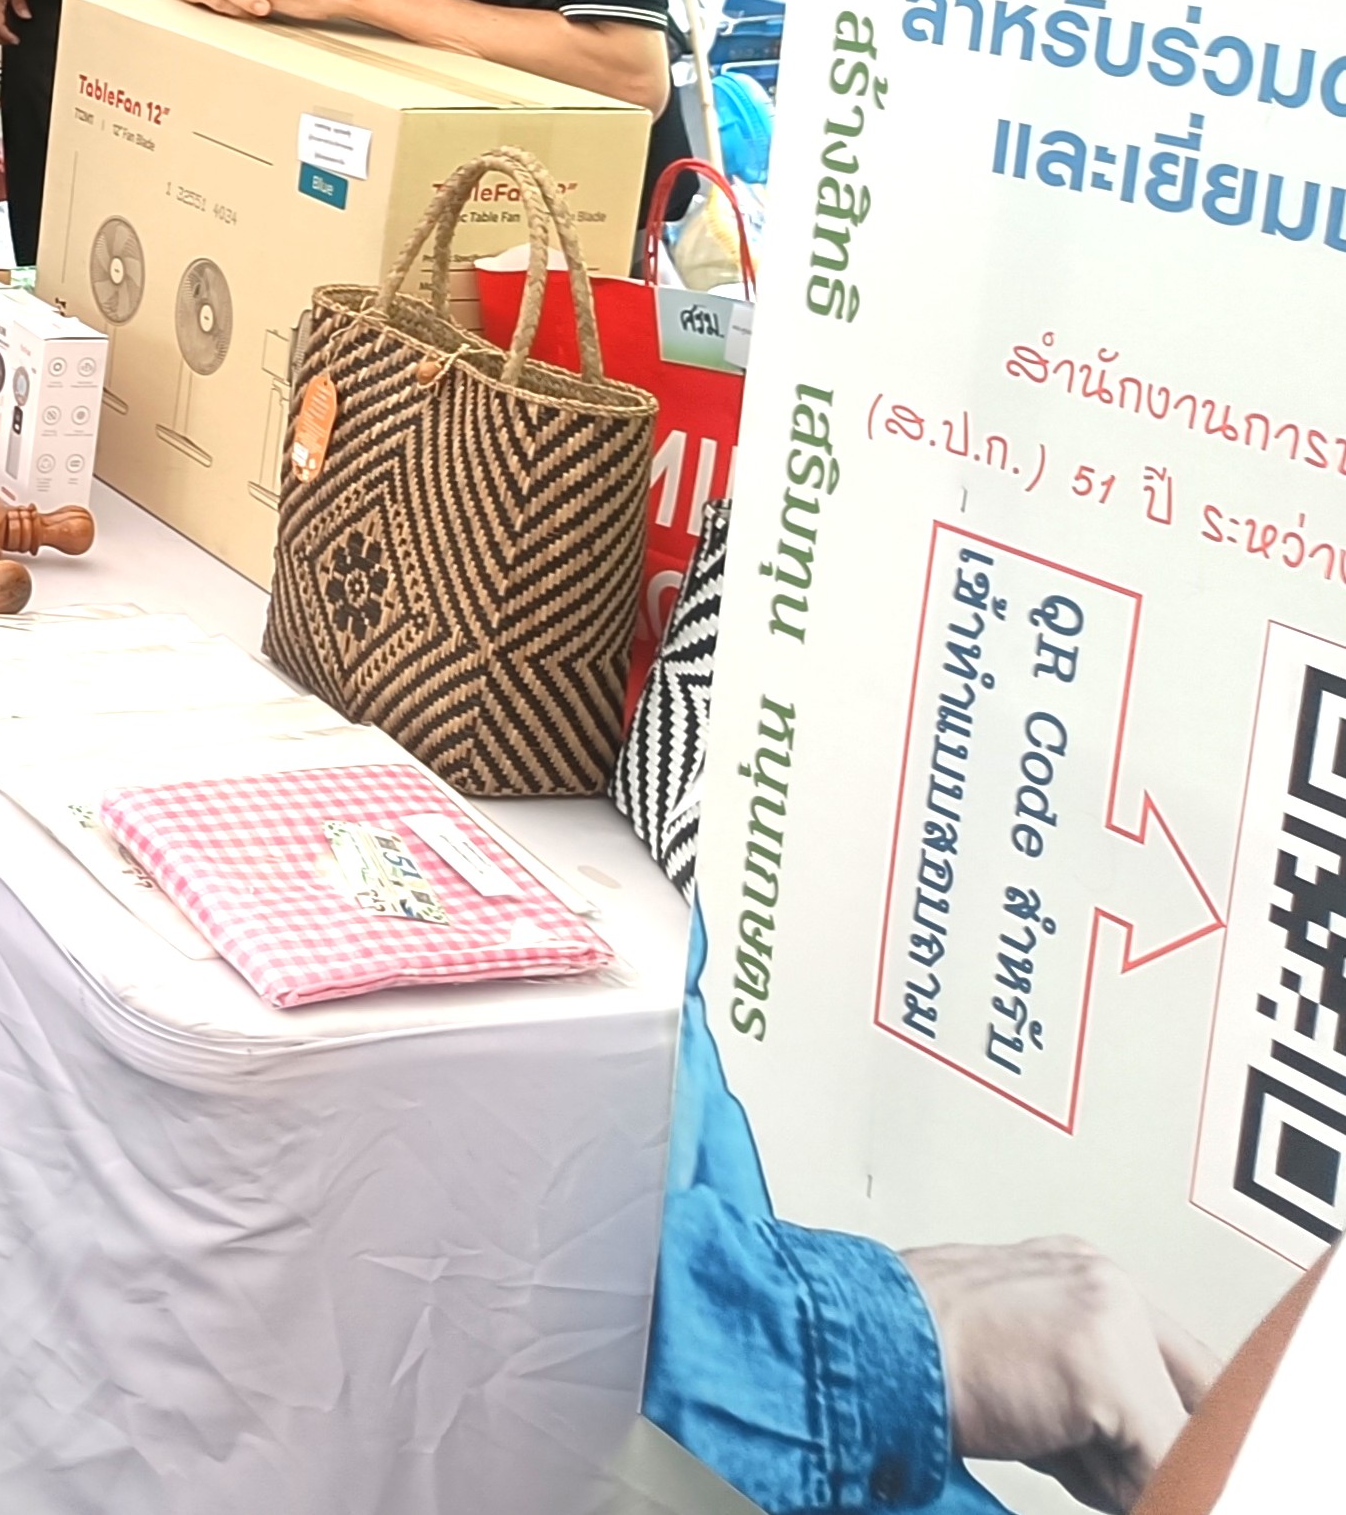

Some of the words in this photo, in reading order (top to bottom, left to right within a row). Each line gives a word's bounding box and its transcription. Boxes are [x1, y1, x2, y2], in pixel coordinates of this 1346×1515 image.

[79, 74, 142, 117] TableFan
[806, 9, 888, 323] สร้างสิทธิ
[312, 175, 334, 196] Blue
[470, 210, 498, 223] Table
[501, 211, 520, 223] Fan
[758, 384, 840, 643] เสริมทุน
[867, 394, 1046, 492] (ส.ป.ก.)
[1072, 465, 1116, 504] 51
[1143, 466, 1173, 525] ปี
[1027, 593, 1086, 684] QR
[901, 547, 1008, 1040] เข้าทำแบบสอบถาม
[1013, 709, 1070, 860] Code
[730, 694, 797, 1042] หนุนเกษตร
[985, 885, 1059, 1075] สำหรับ
